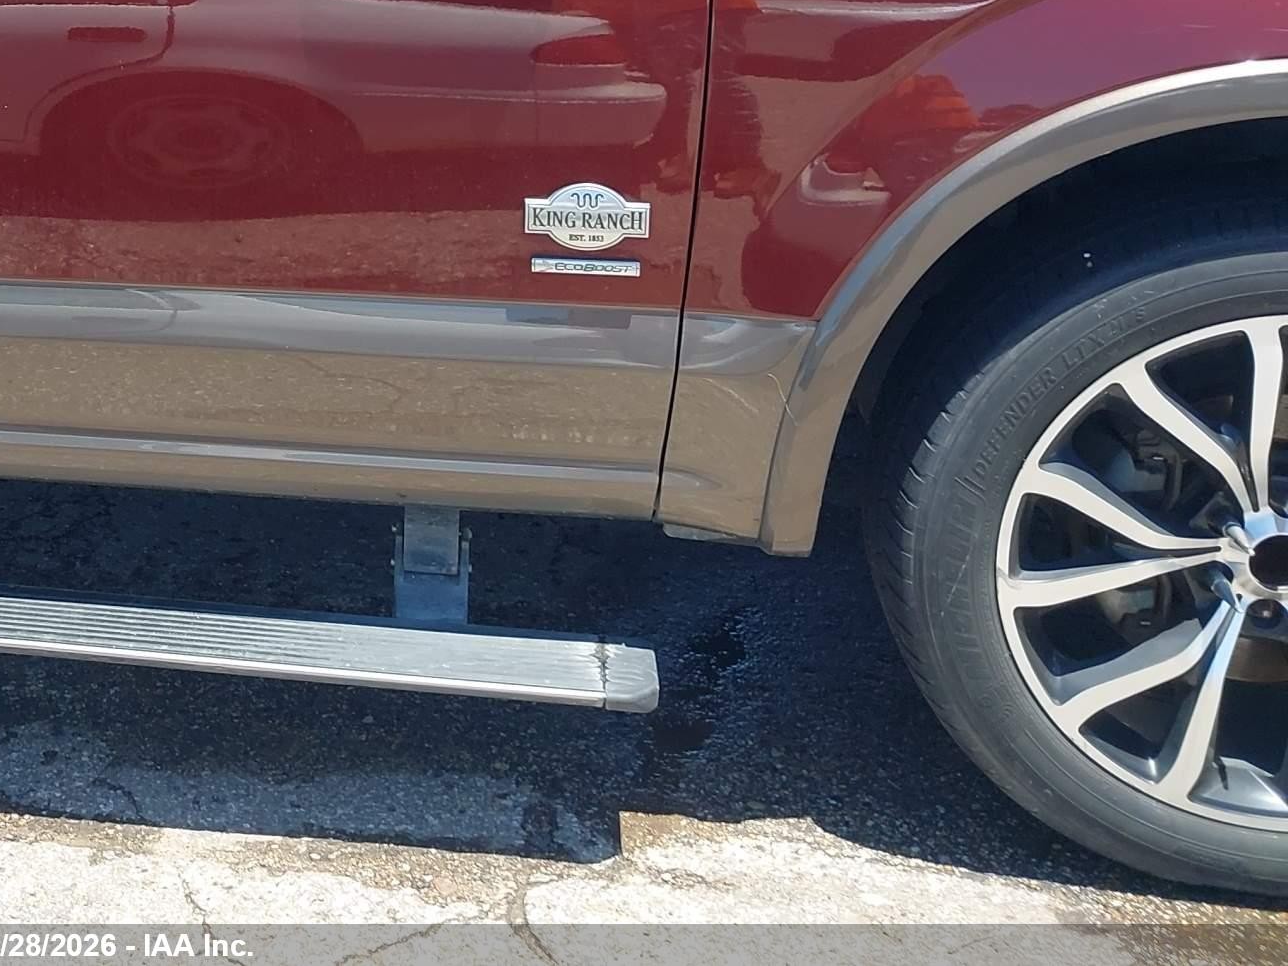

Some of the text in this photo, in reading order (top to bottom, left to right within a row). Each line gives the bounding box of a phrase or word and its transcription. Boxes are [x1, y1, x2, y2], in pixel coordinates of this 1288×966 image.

[532, 207, 644, 231] KING RANCH
[568, 234, 586, 242] EST.
[974, 366, 1058, 478] DEFENDER
